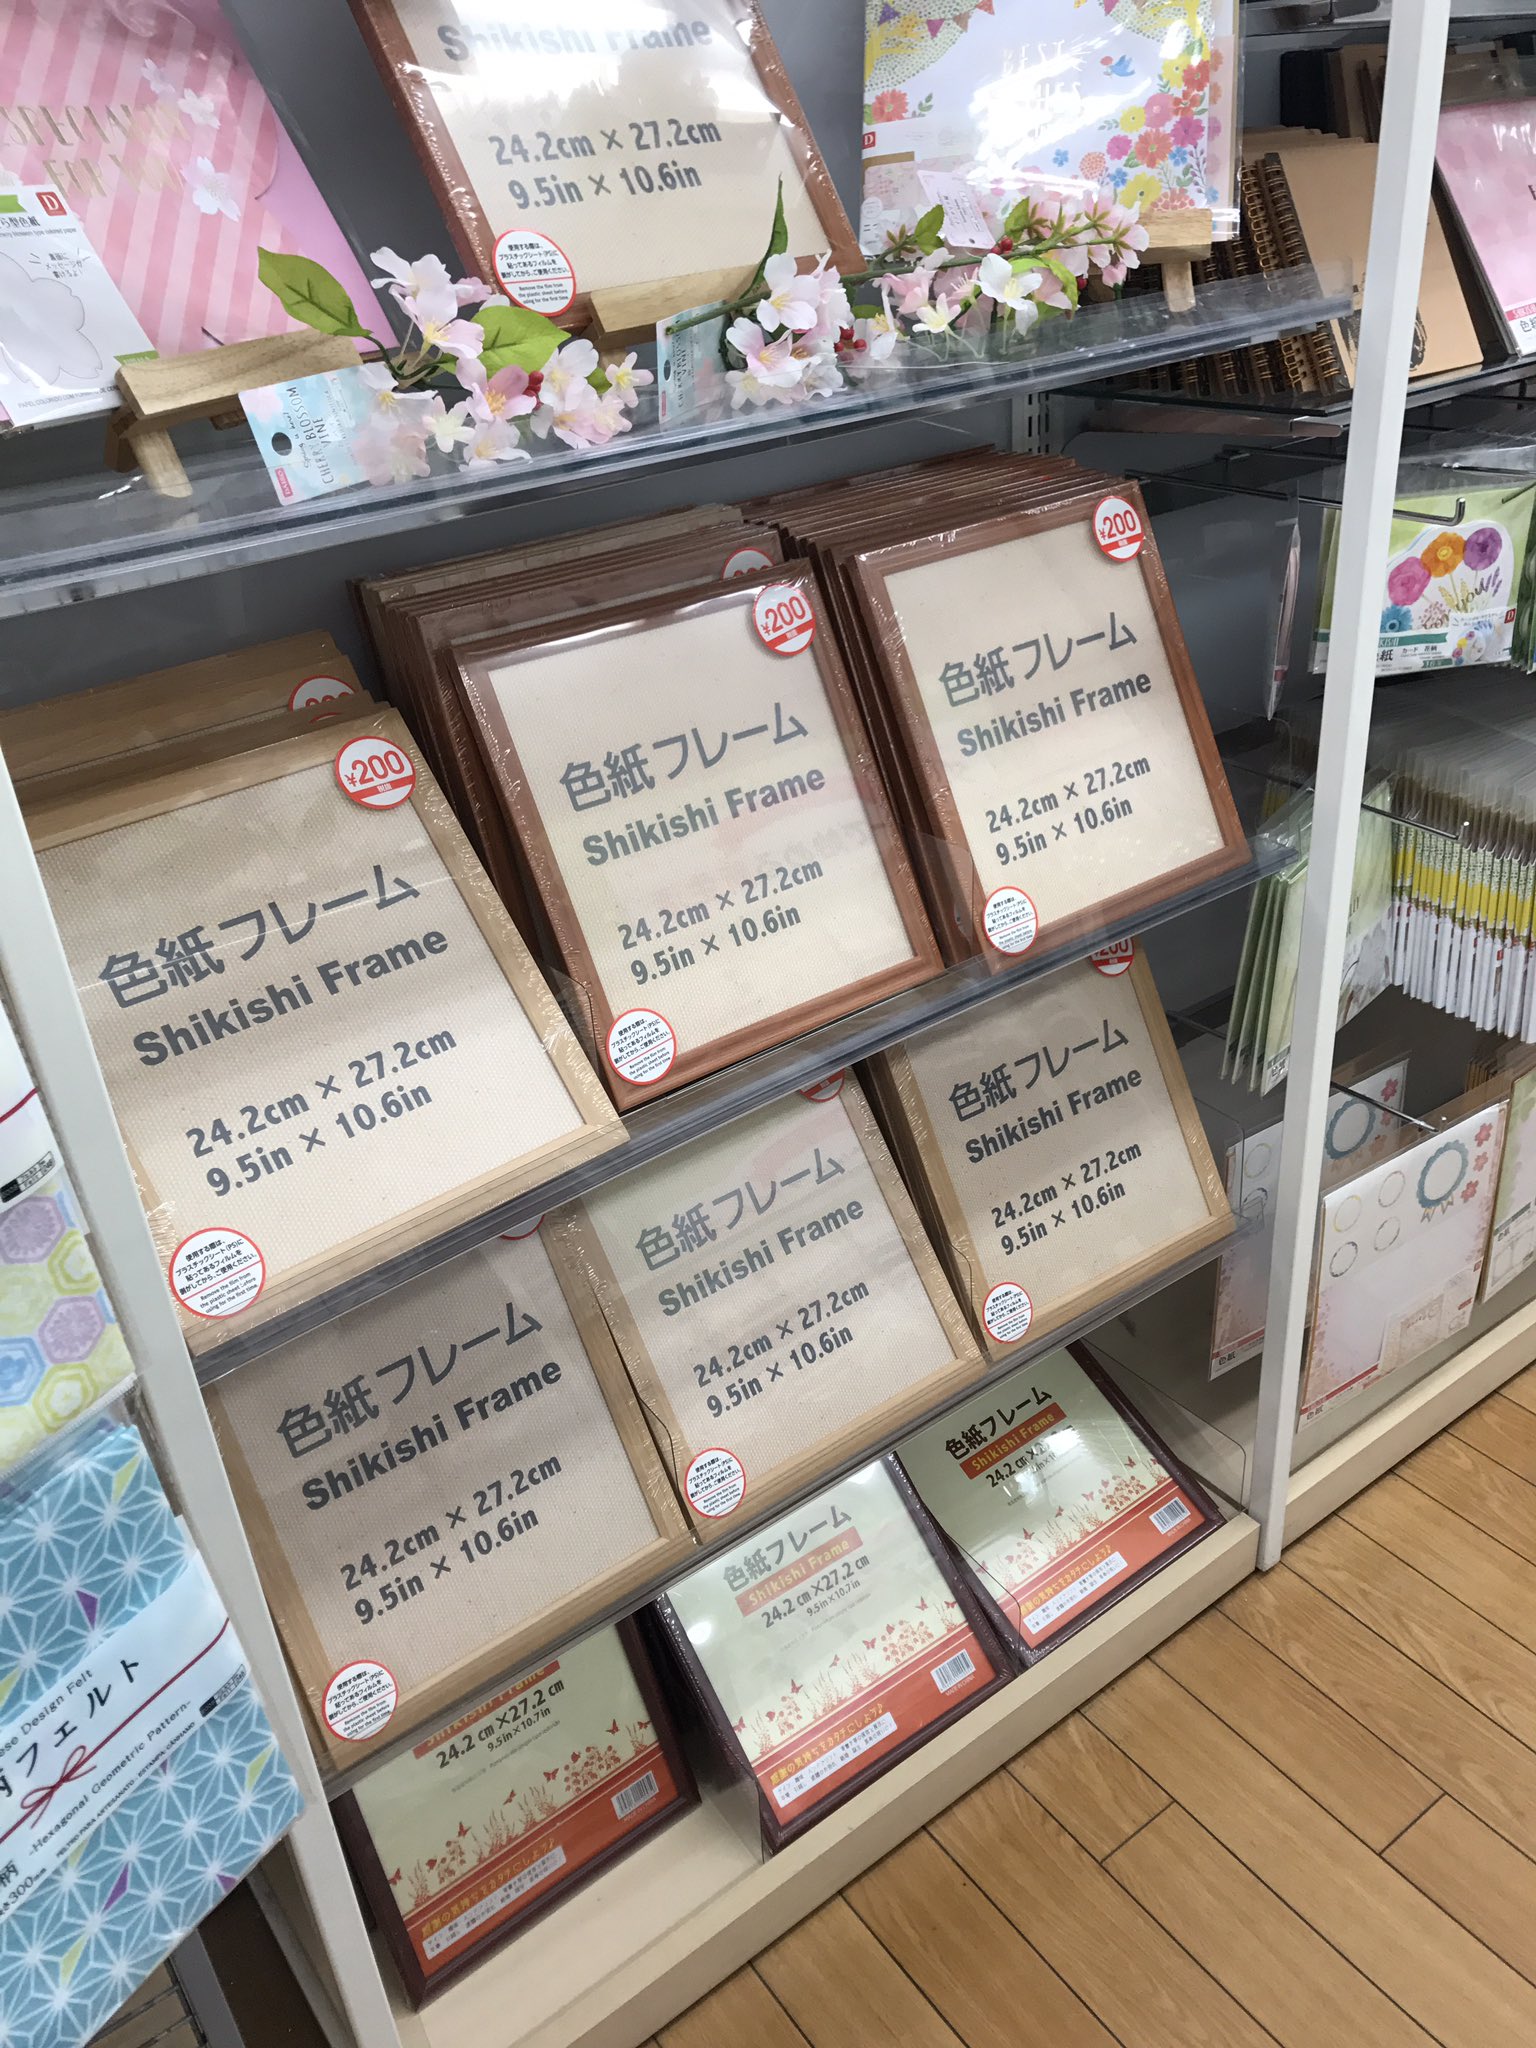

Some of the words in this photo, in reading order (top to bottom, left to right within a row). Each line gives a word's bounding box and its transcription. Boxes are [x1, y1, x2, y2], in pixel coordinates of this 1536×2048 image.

[489, 131, 596, 165] 24.2cm
[628, 118, 722, 151] 27.2cm
[508, 174, 584, 210] 9.5in
[619, 160, 702, 195] 10.6in
[285, 386, 318, 442] BLOSSOM
[313, 418, 331, 446] VINE
[1098, 510, 1136, 540] ¥200
[760, 596, 806, 636] ¥200
[939, 611, 1137, 708] 色紙フレーム
[559, 702, 808, 812] 色紙フレーム
[957, 699, 1066, 758] Shikishi
[1070, 670, 1152, 716] Frame
[344, 750, 404, 787] ¥200
[985, 792, 1060, 834] 24.2cm
[1083, 755, 1151, 796] 27.2cm
[582, 798, 721, 866] Shikishi
[728, 766, 825, 817] Frame
[996, 827, 1048, 865] 9.5in
[1074, 796, 1134, 834] 10.6in
[99, 864, 420, 1009] 色紙フレーム
[618, 903, 711, 949] 24.2cm
[741, 857, 823, 904] 27.2cm
[631, 940, 696, 985] 9.5in
[728, 905, 802, 948] 10.6in
[133, 975, 312, 1068] Shikishi
[318, 928, 449, 989] Frame
[186, 1086, 309, 1158] 24.2cm
[347, 1027, 456, 1089] 27.2cm
[949, 1018, 1129, 1122] 色紙フレーム
[205, 1141, 294, 1199] 9.5in
[336, 1082, 432, 1141] 10.6in
[965, 1101, 1064, 1164] Shikishi
[1067, 1068, 1143, 1117] Frame
[635, 1147, 845, 1272] 色紙フレーム
[991, 1184, 1058, 1228] 24.2cm
[1079, 1142, 1142, 1183] 27.2cm
[1001, 1222, 1047, 1256] 9.5in
[1071, 1179, 1126, 1219] 10.6in
[185, 1250, 242, 1282] 貼ってあるフィルムを
[210, 1293, 225, 1304] plastic
[658, 1239, 774, 1317] Shikishi
[779, 1198, 864, 1254] Frame
[206, 1303, 219, 1313] using
[693, 1332, 773, 1388] 24.2cm
[798, 1279, 870, 1329] 27.2cm
[276, 1302, 543, 1459] 色紙フレーム
[706, 1378, 763, 1418] 9.5in
[789, 1324, 854, 1371] 10.6in
[300, 1414, 449, 1512] Shikishi
[455, 1361, 562, 1430] Frame
[946, 1387, 1052, 1460] 色紙フレーム
[972, 1434, 1020, 1471] Shikishi
[1019, 1413, 1055, 1439] Frame
[986, 1463, 1016, 1488] 24.2
[340, 1521, 440, 1591] 24.2cm
[473, 1455, 562, 1516] 27.2cm
[355, 1572, 425, 1625] 9.5in
[461, 1507, 539, 1564] 10.6in
[723, 1505, 851, 1592] 色紙フレーム
[749, 1563, 806, 1606] Shikishi
[809, 1540, 850, 1570] Frame
[761, 1598, 796, 1628] 24.2
[797, 1592, 811, 1607] cm
[855, 1555, 870, 1570] cm
[20, 1696, 64, 1735] Design
[66, 1670, 92, 1694] Felt
[436, 1735, 475, 1769] 24.2
[478, 1725, 495, 1741] cm
[548, 1680, 565, 1696] cm
[92, 1743, 145, 1795] Geometric
